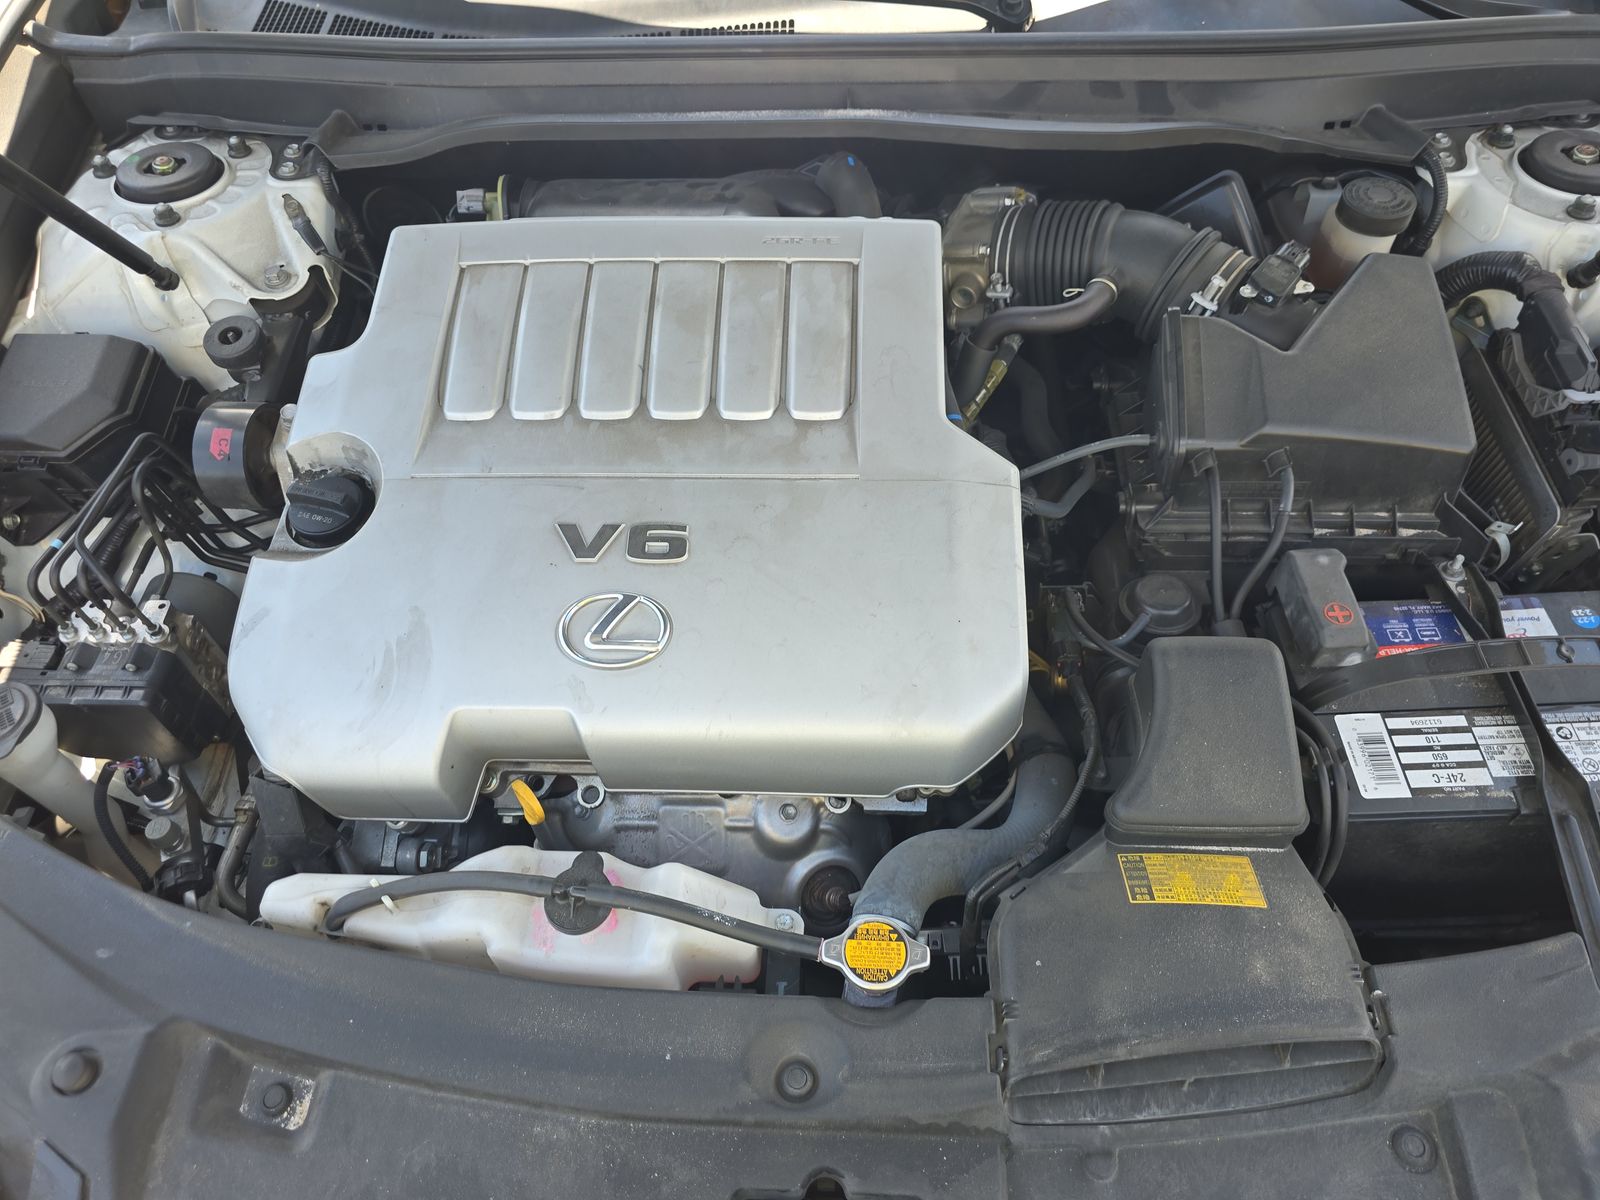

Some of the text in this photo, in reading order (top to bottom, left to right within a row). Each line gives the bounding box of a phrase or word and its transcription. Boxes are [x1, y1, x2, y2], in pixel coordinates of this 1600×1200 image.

[312, 514, 332, 523] 0W-20
[555, 522, 690, 563] V6
[1425, 736, 1441, 744] 110
[1432, 753, 1448, 761] 650
[1432, 772, 1466, 783] 24F-C
